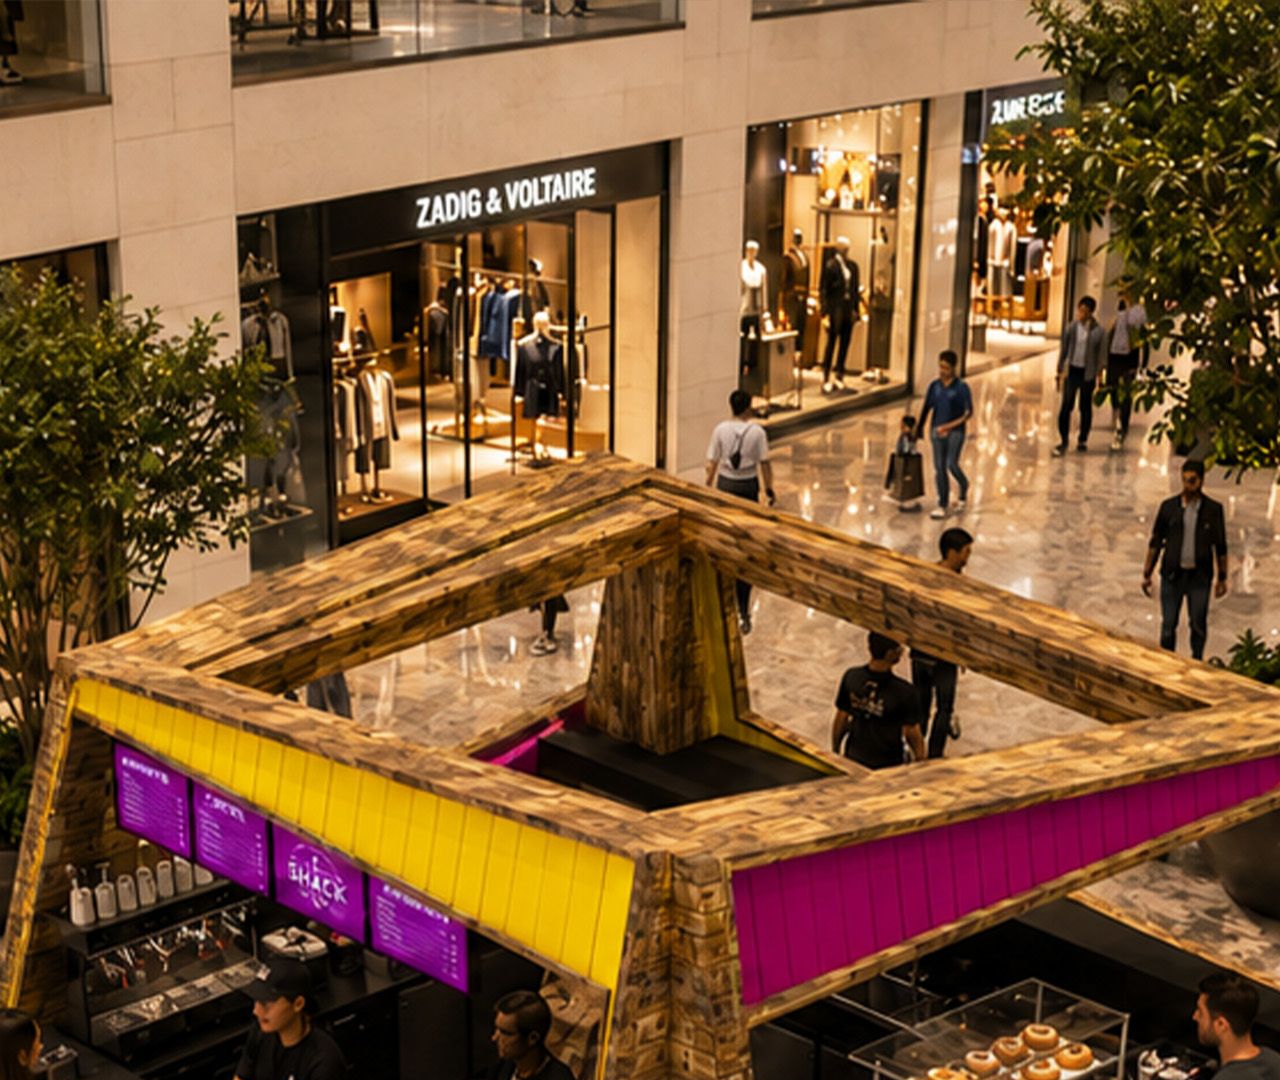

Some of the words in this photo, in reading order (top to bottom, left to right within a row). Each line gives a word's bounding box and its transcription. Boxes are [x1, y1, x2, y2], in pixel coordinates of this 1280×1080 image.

[415, 187, 483, 229] ZADIG
[485, 186, 503, 216] &
[504, 166, 597, 212] VOLTAIRE
